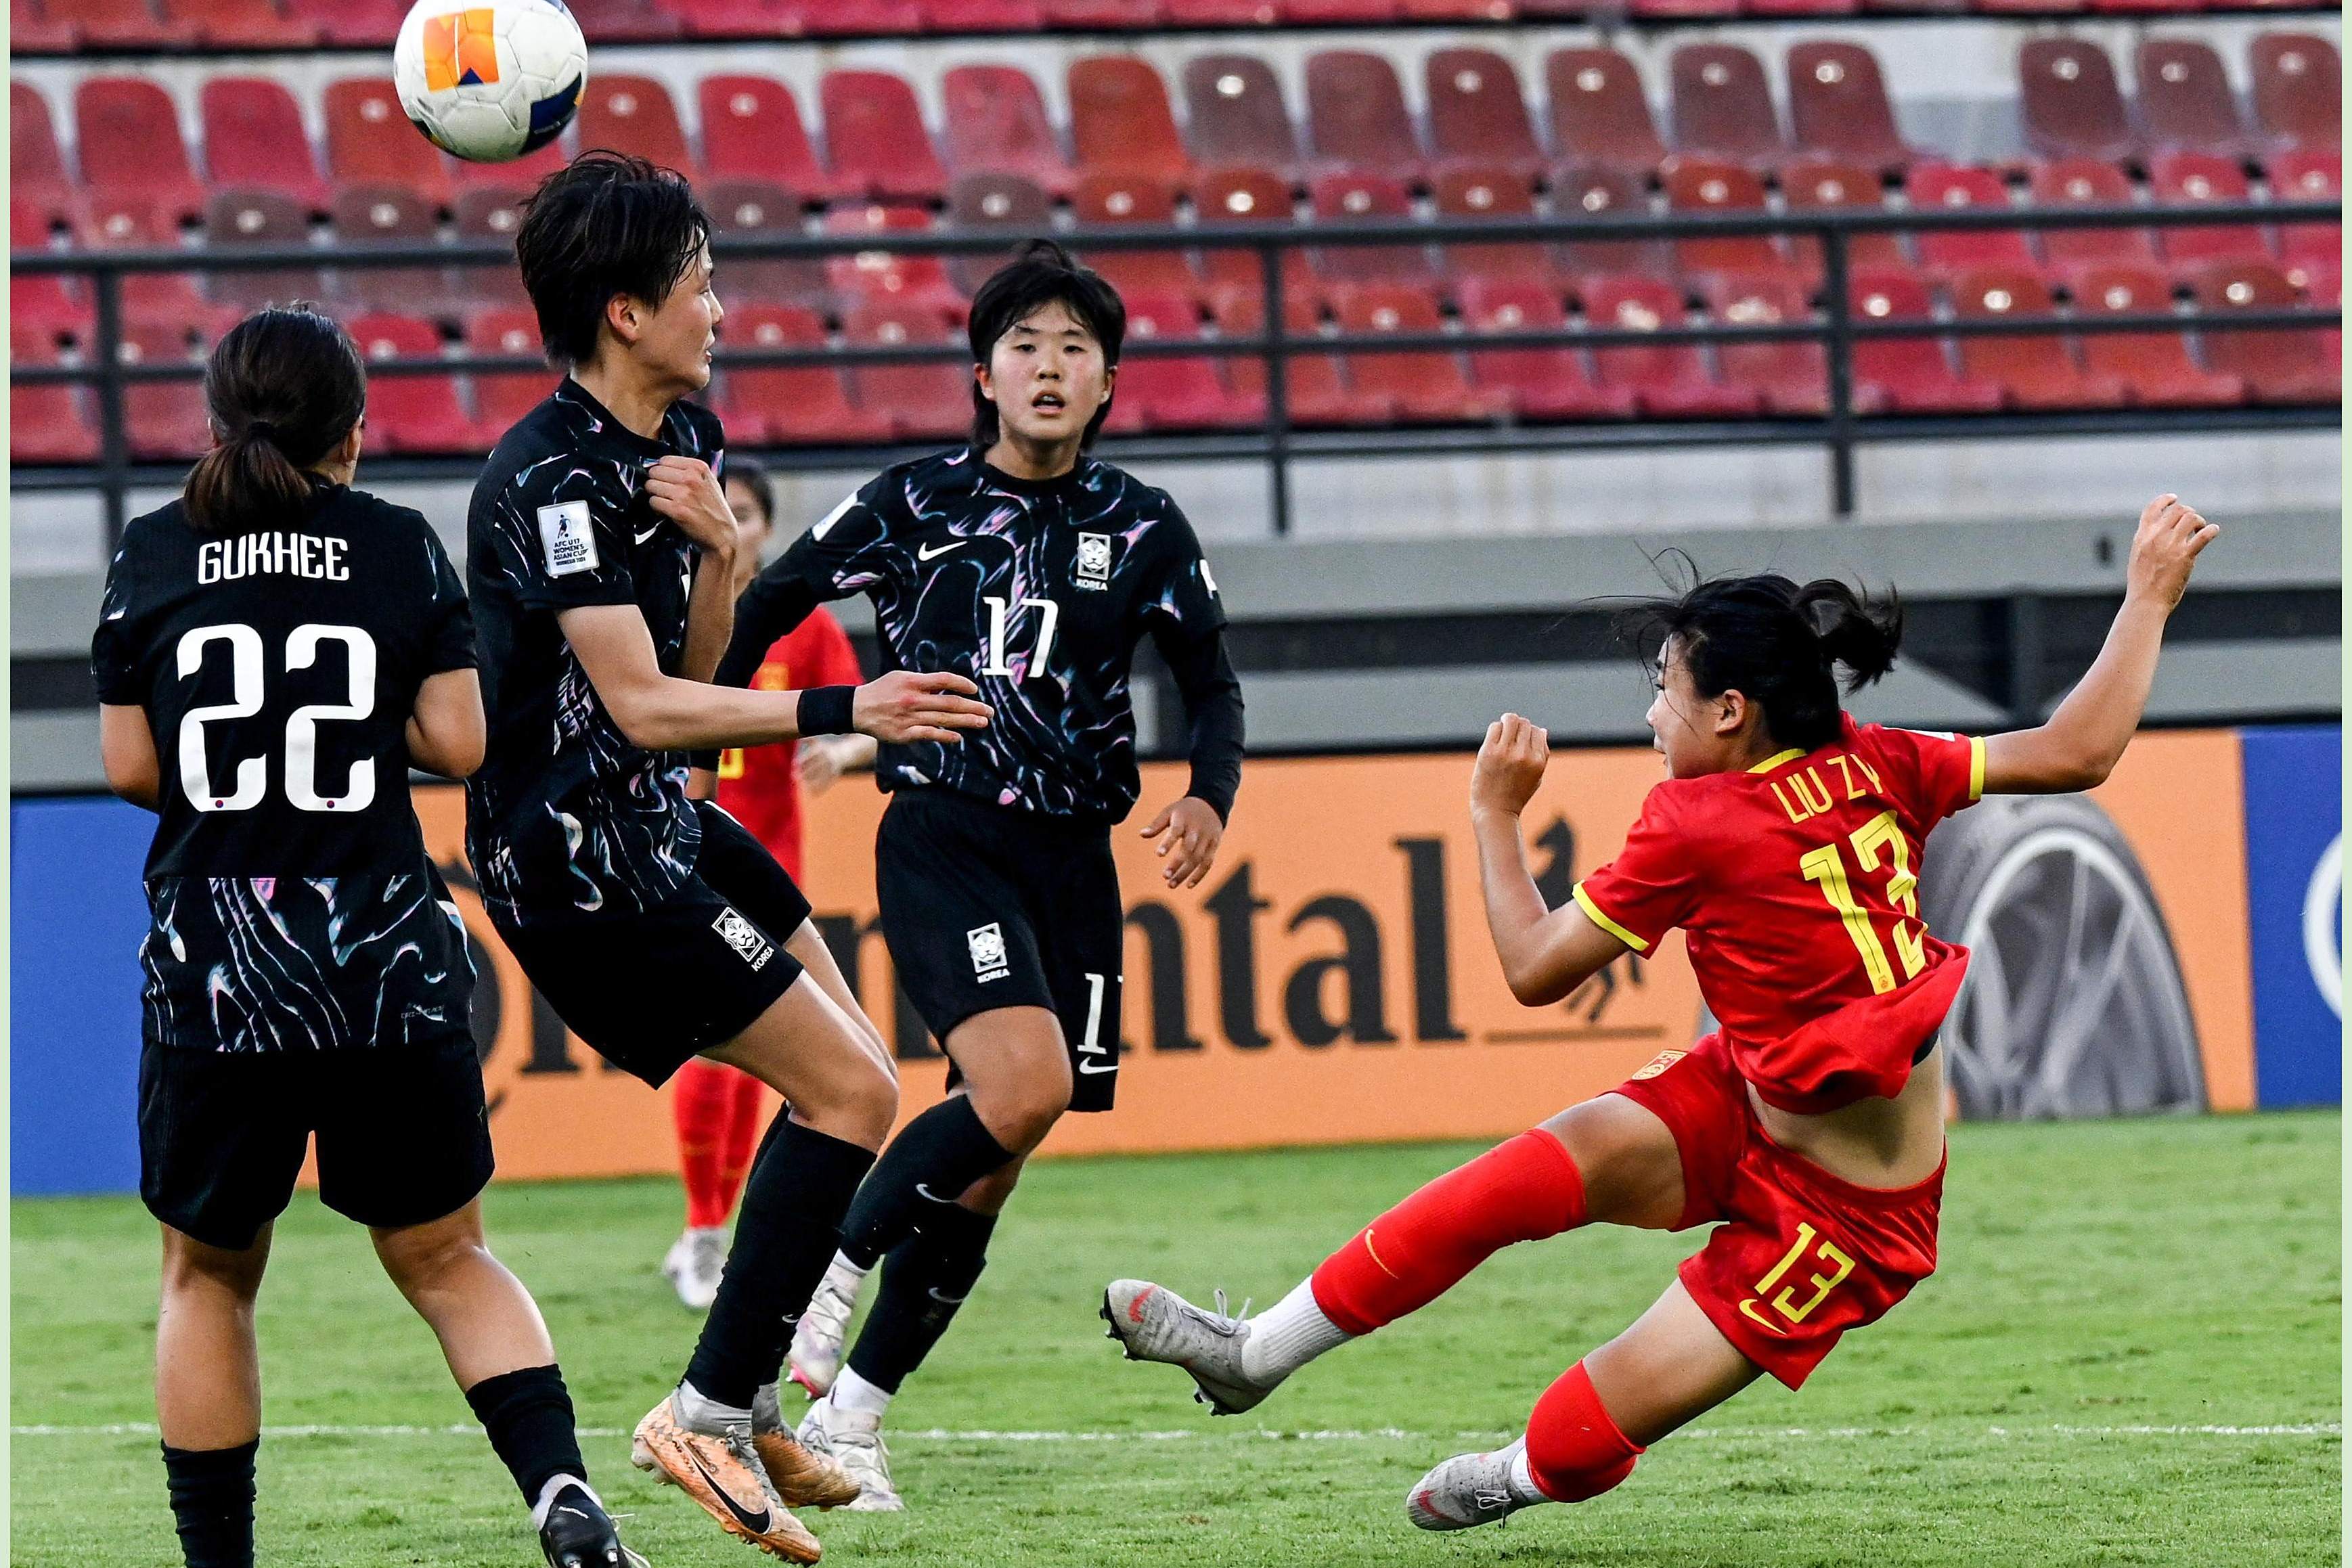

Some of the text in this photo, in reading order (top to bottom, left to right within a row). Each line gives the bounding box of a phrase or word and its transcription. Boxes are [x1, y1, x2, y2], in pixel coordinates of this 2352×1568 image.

[198, 531, 350, 585] GUKHEE
[553, 552, 573, 560] ASIAN
[554, 540, 567, 548] AFC
[1076, 578, 1109, 591] KOREA
[981, 596, 1059, 679] 17
[176, 623, 377, 813] 22
[1770, 753, 1884, 824] LIU ZY
[1799, 809, 1929, 995] 13
[751, 945, 775, 972] KOREA
[977, 968, 1011, 984] KOREA
[1076, 972, 1124, 1055] 1
[1754, 1222, 1856, 1324] 13
